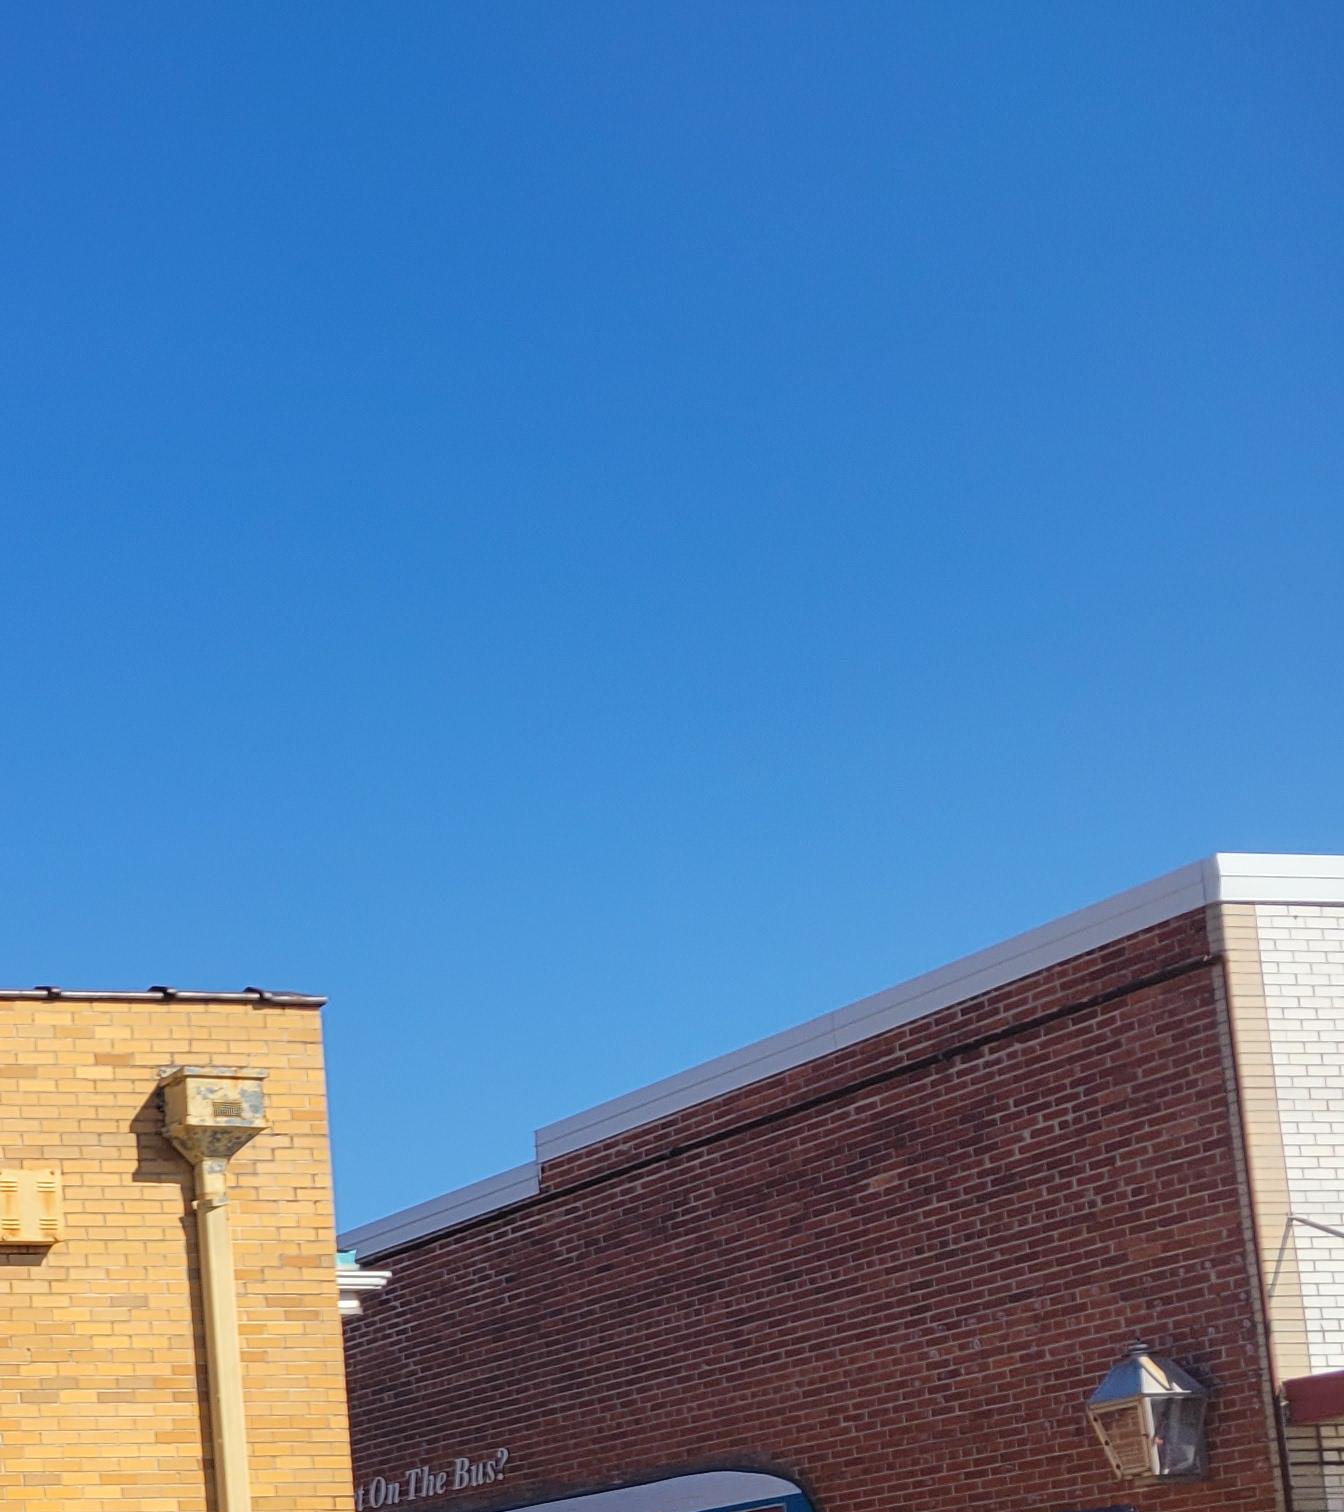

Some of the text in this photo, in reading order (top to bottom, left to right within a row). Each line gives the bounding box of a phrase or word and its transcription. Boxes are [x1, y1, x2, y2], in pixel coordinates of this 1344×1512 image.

[369, 1476, 400, 1508] On
[405, 1465, 447, 1500] The
[452, 1447, 509, 1490] Bus?
